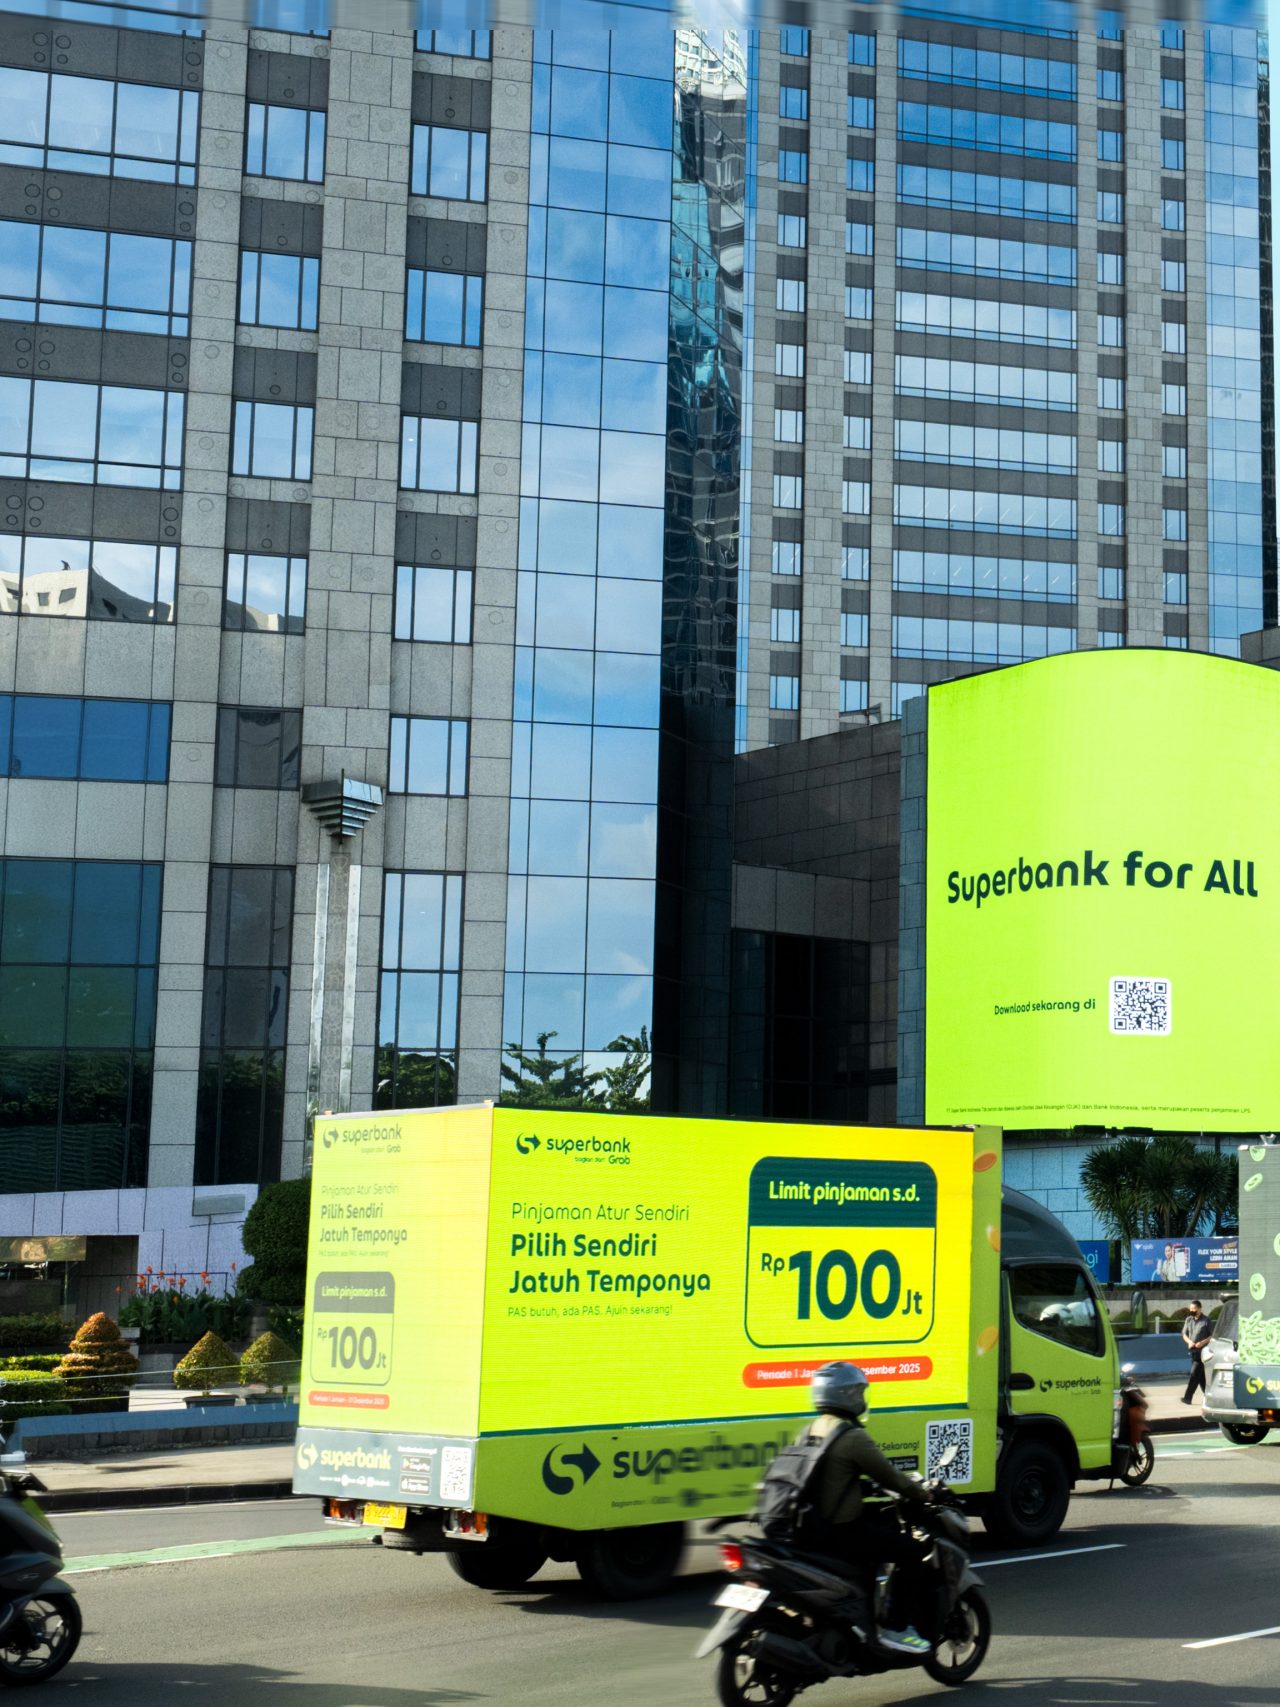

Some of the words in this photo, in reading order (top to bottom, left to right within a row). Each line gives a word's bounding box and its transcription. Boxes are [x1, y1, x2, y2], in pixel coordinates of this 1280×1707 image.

[948, 850, 1110, 908] Superbank
[1123, 850, 1193, 889] for
[1203, 859, 1258, 898] All
[994, 1001, 1031, 1015] Download
[1032, 1000, 1080, 1012] sekarang
[1083, 998, 1096, 1009] di
[342, 1124, 402, 1145] superbank
[546, 1136, 630, 1154] superbank
[608, 1155, 630, 1165] Grab
[769, 1181, 811, 1200] Limit
[814, 1182, 890, 1206] pinjaman
[893, 1184, 920, 1202] s.d.
[320, 1204, 344, 1219] Pilih
[346, 1203, 383, 1219] Sendiri
[512, 1202, 591, 1224] Pinjaman
[596, 1204, 630, 1220] Atur
[635, 1205, 689, 1221] Sendiri
[319, 1227, 349, 1242] Jatuh
[351, 1227, 408, 1246] Temponya
[511, 1232, 567, 1257] Pilih
[573, 1233, 657, 1257] Sendiri
[509, 1268, 579, 1293] Jatuh
[587, 1270, 711, 1298] Temponya
[761, 1253, 784, 1276] Rp
[788, 1249, 901, 1320] 100
[902, 1289, 922, 1315] Jt
[321, 1286, 339, 1297] Limit
[339, 1286, 373, 1300] pinjaman
[508, 1307, 527, 1317] PAS
[530, 1306, 559, 1318] butuh,
[562, 1306, 579, 1316] ada
[582, 1305, 603, 1316] PAS.
[605, 1305, 628, 1319] Ajuin
[630, 1304, 673, 1317] sekarang!
[317, 1327, 328, 1341] Rp
[328, 1326, 377, 1370] 100
[376, 1352, 387, 1369] Jt
[899, 1363, 921, 1374] 2025
[1056, 1376, 1101, 1390] superbank
[882, 1441, 920, 1451] Sekarang!
[320, 1447, 392, 1471] superbank
